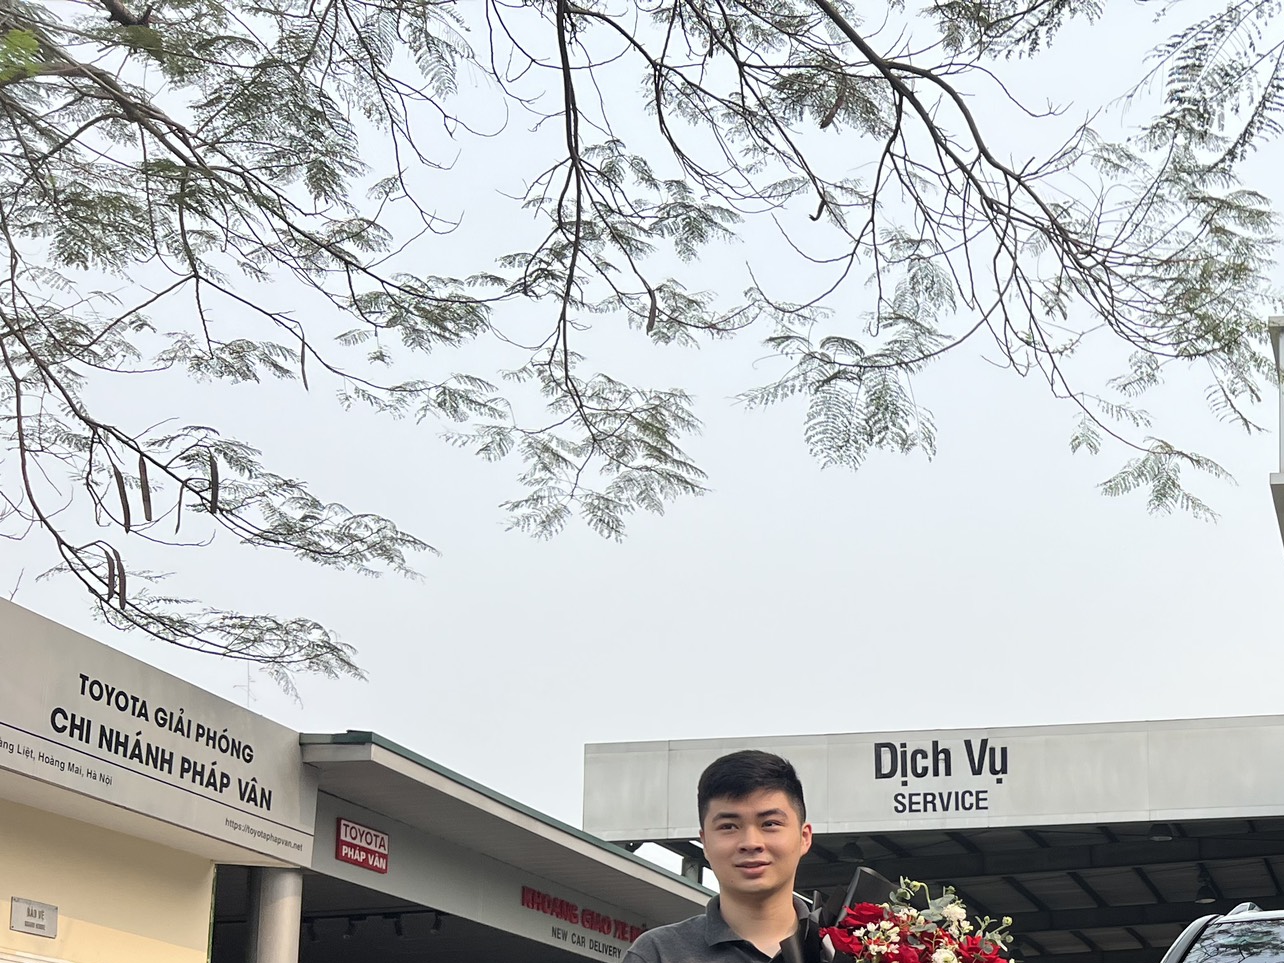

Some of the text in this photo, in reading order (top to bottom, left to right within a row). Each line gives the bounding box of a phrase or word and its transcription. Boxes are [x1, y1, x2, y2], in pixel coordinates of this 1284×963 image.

[79, 673, 254, 763] TOYOTA GIẢI PHÓNG
[38, 752, 66, 772] Hoàng
[67, 762, 84, 778] Mai,
[86, 768, 97, 780] Hà
[99, 772, 113, 786] Nội
[50, 707, 273, 811] CHI NHÁNH PHÁP VÂN
[874, 738, 1008, 786] Dịch Vụ
[893, 789, 989, 814] SERVICE
[342, 823, 387, 851] TOYOTA
[341, 845, 387, 870] PHÁP VÂN
[551, 926, 622, 959] NEW CAR DELIVERY
